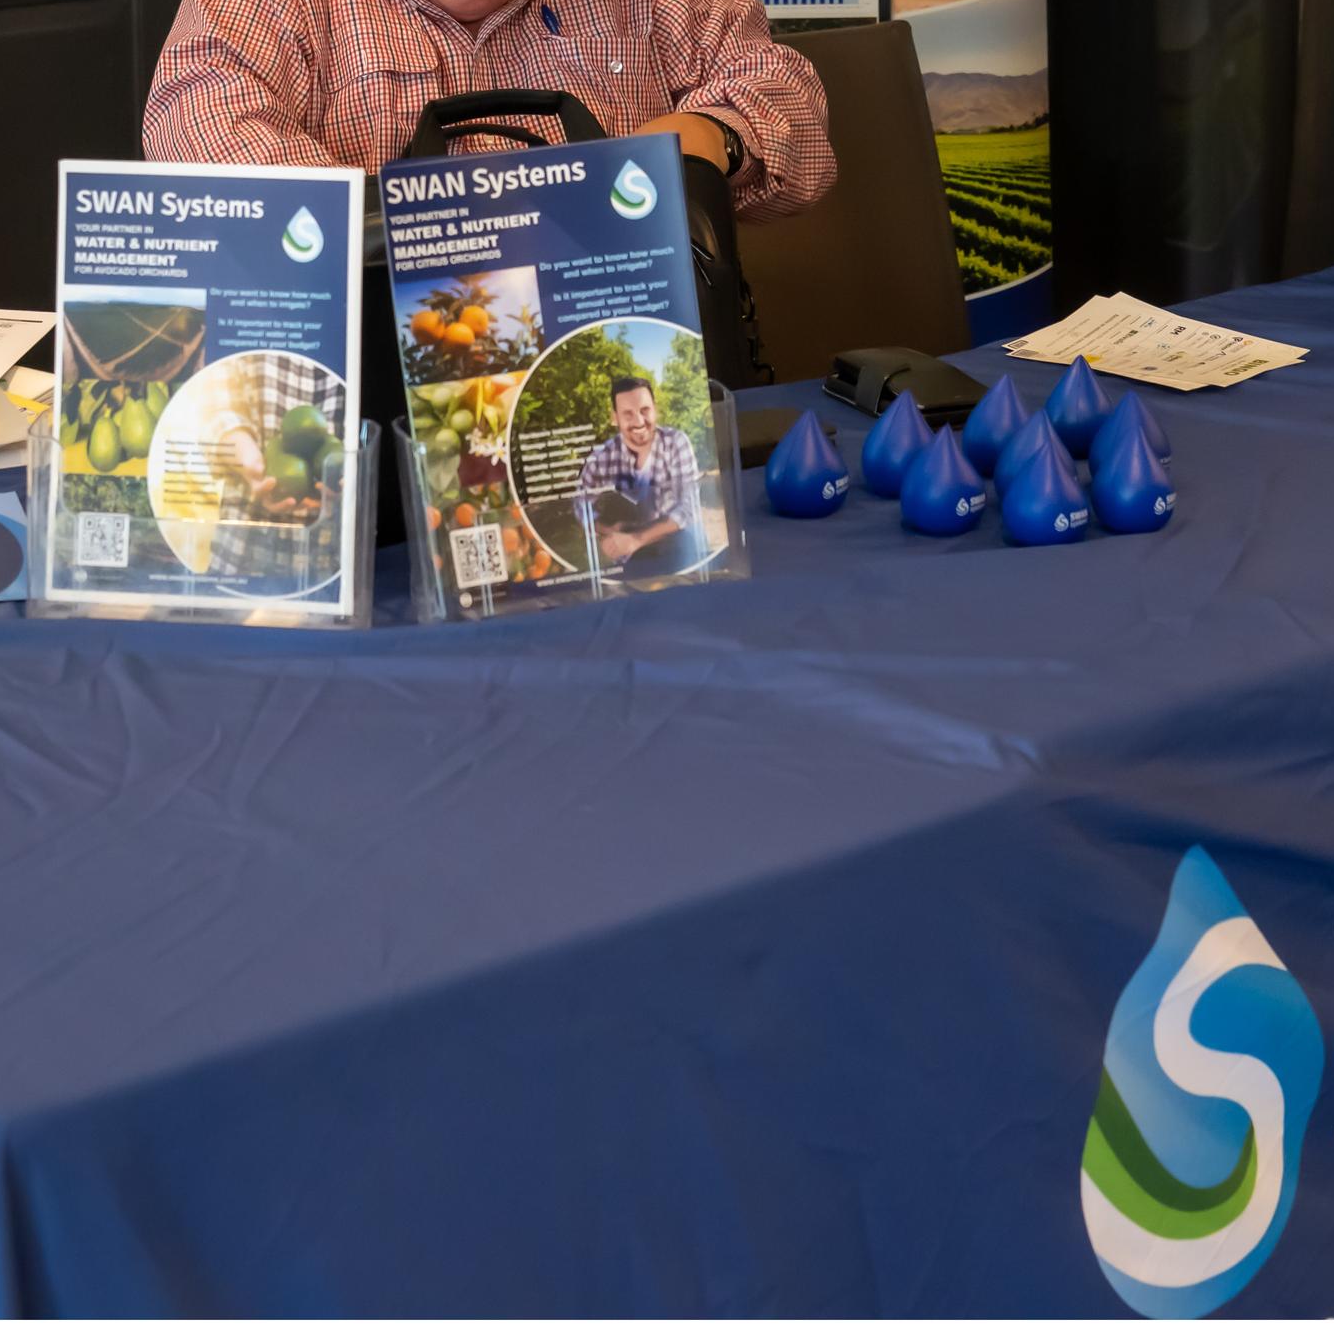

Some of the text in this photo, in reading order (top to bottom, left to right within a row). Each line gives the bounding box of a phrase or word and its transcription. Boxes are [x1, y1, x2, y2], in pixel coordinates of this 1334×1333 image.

[386, 161, 587, 204] SWAN Systems
[76, 189, 265, 223] SWAN Systems
[389, 206, 469, 225] YOUR PARTNER IN
[75, 223, 155, 235] YOUR PARTNER IN
[391, 211, 541, 243] WATER & NUTRIENT
[75, 236, 220, 253] WATER & NUTRIENT
[393, 234, 500, 260] MANAGEMENT
[74, 251, 178, 267] MANAGEMENT
